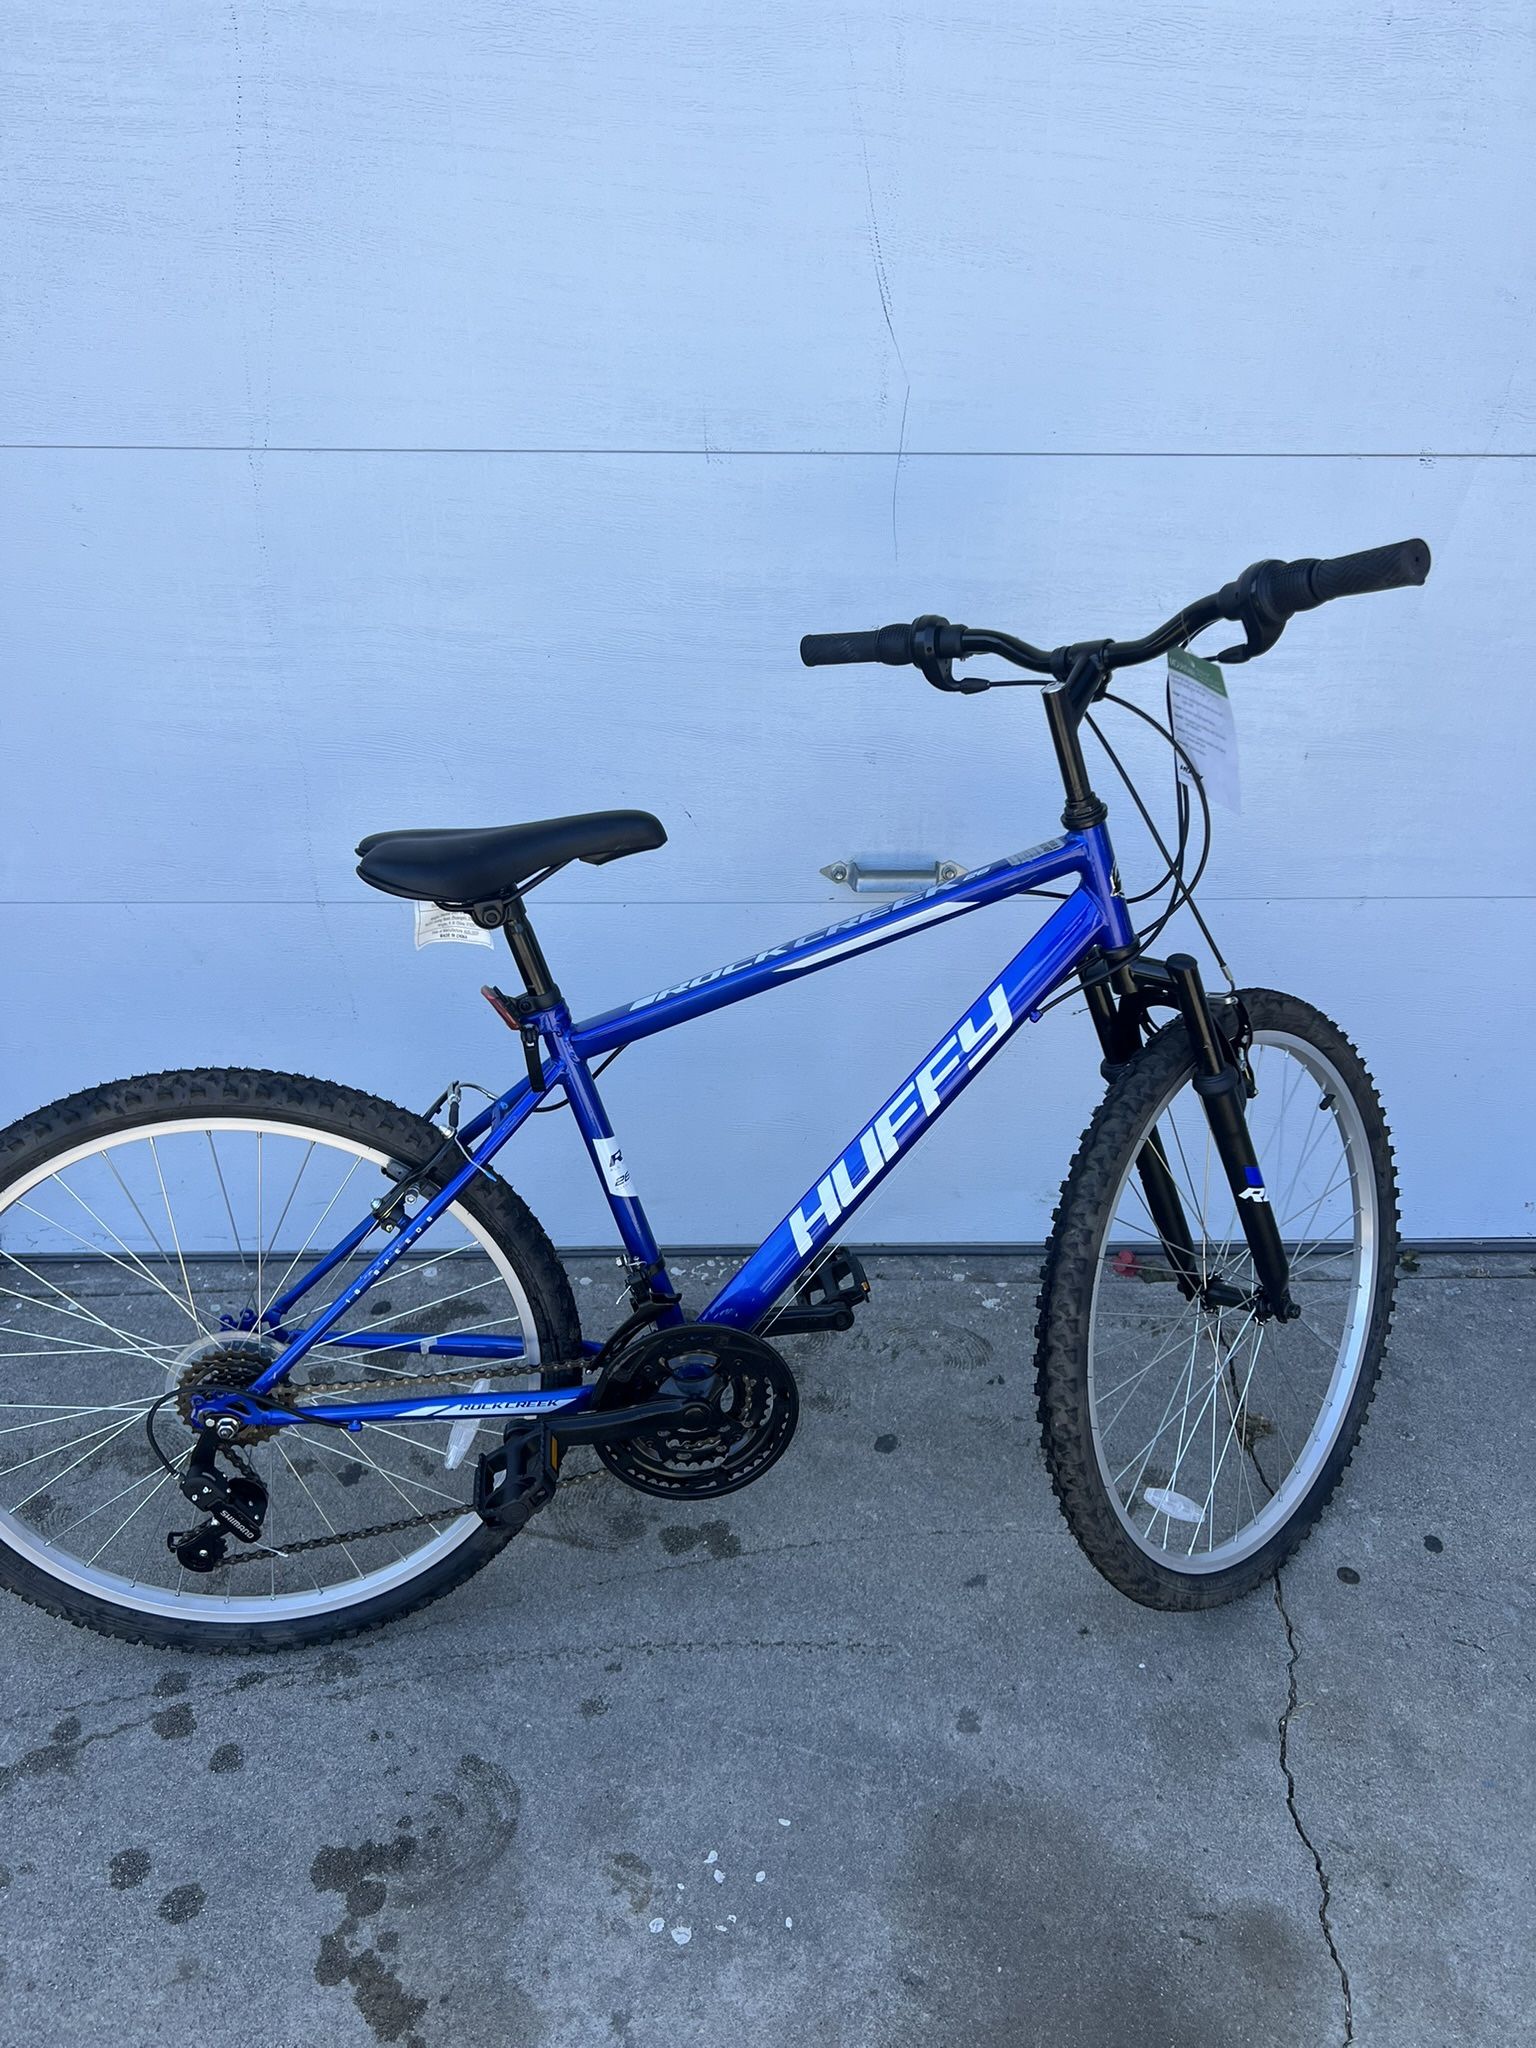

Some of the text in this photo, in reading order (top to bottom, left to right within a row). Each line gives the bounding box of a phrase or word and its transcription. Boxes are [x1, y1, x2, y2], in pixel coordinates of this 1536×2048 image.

[788, 983, 1013, 1257] HUFFY
[373, 1216, 433, 1275] SPEEDS
[220, 1510, 254, 1539] SHIMANO
